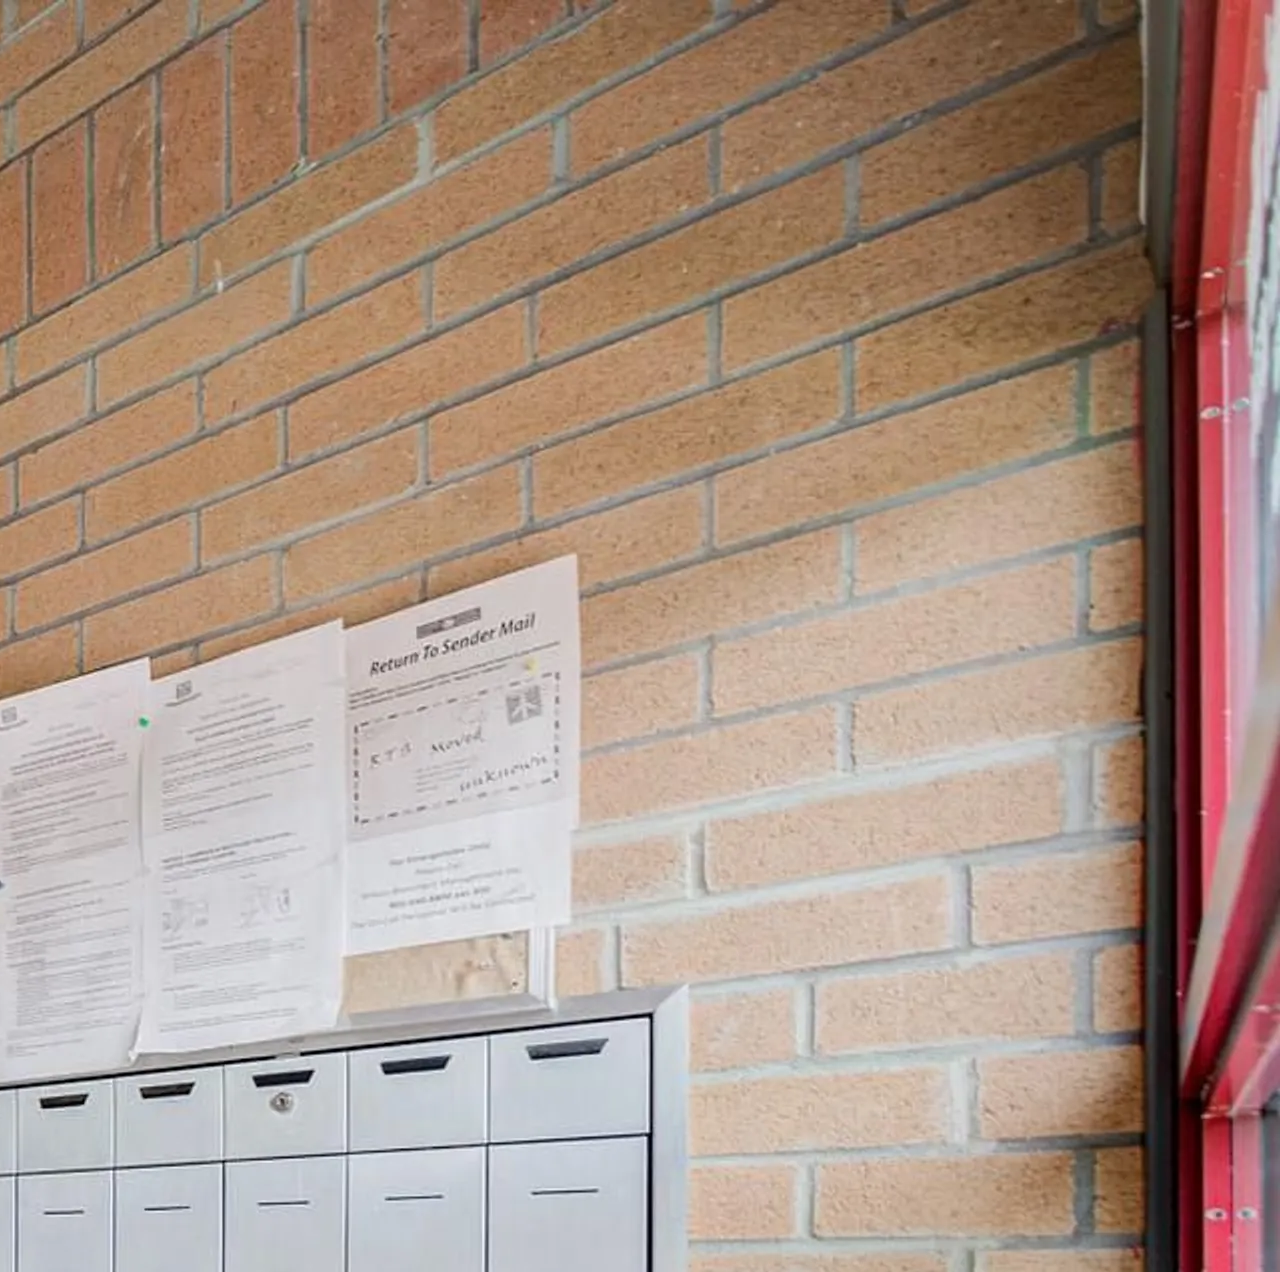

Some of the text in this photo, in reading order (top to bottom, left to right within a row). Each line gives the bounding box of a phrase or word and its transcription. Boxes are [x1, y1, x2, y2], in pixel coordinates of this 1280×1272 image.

[369, 651, 419, 676] Return
[422, 644, 440, 661] To
[442, 630, 495, 656] Sender
[499, 612, 536, 638] Mail
